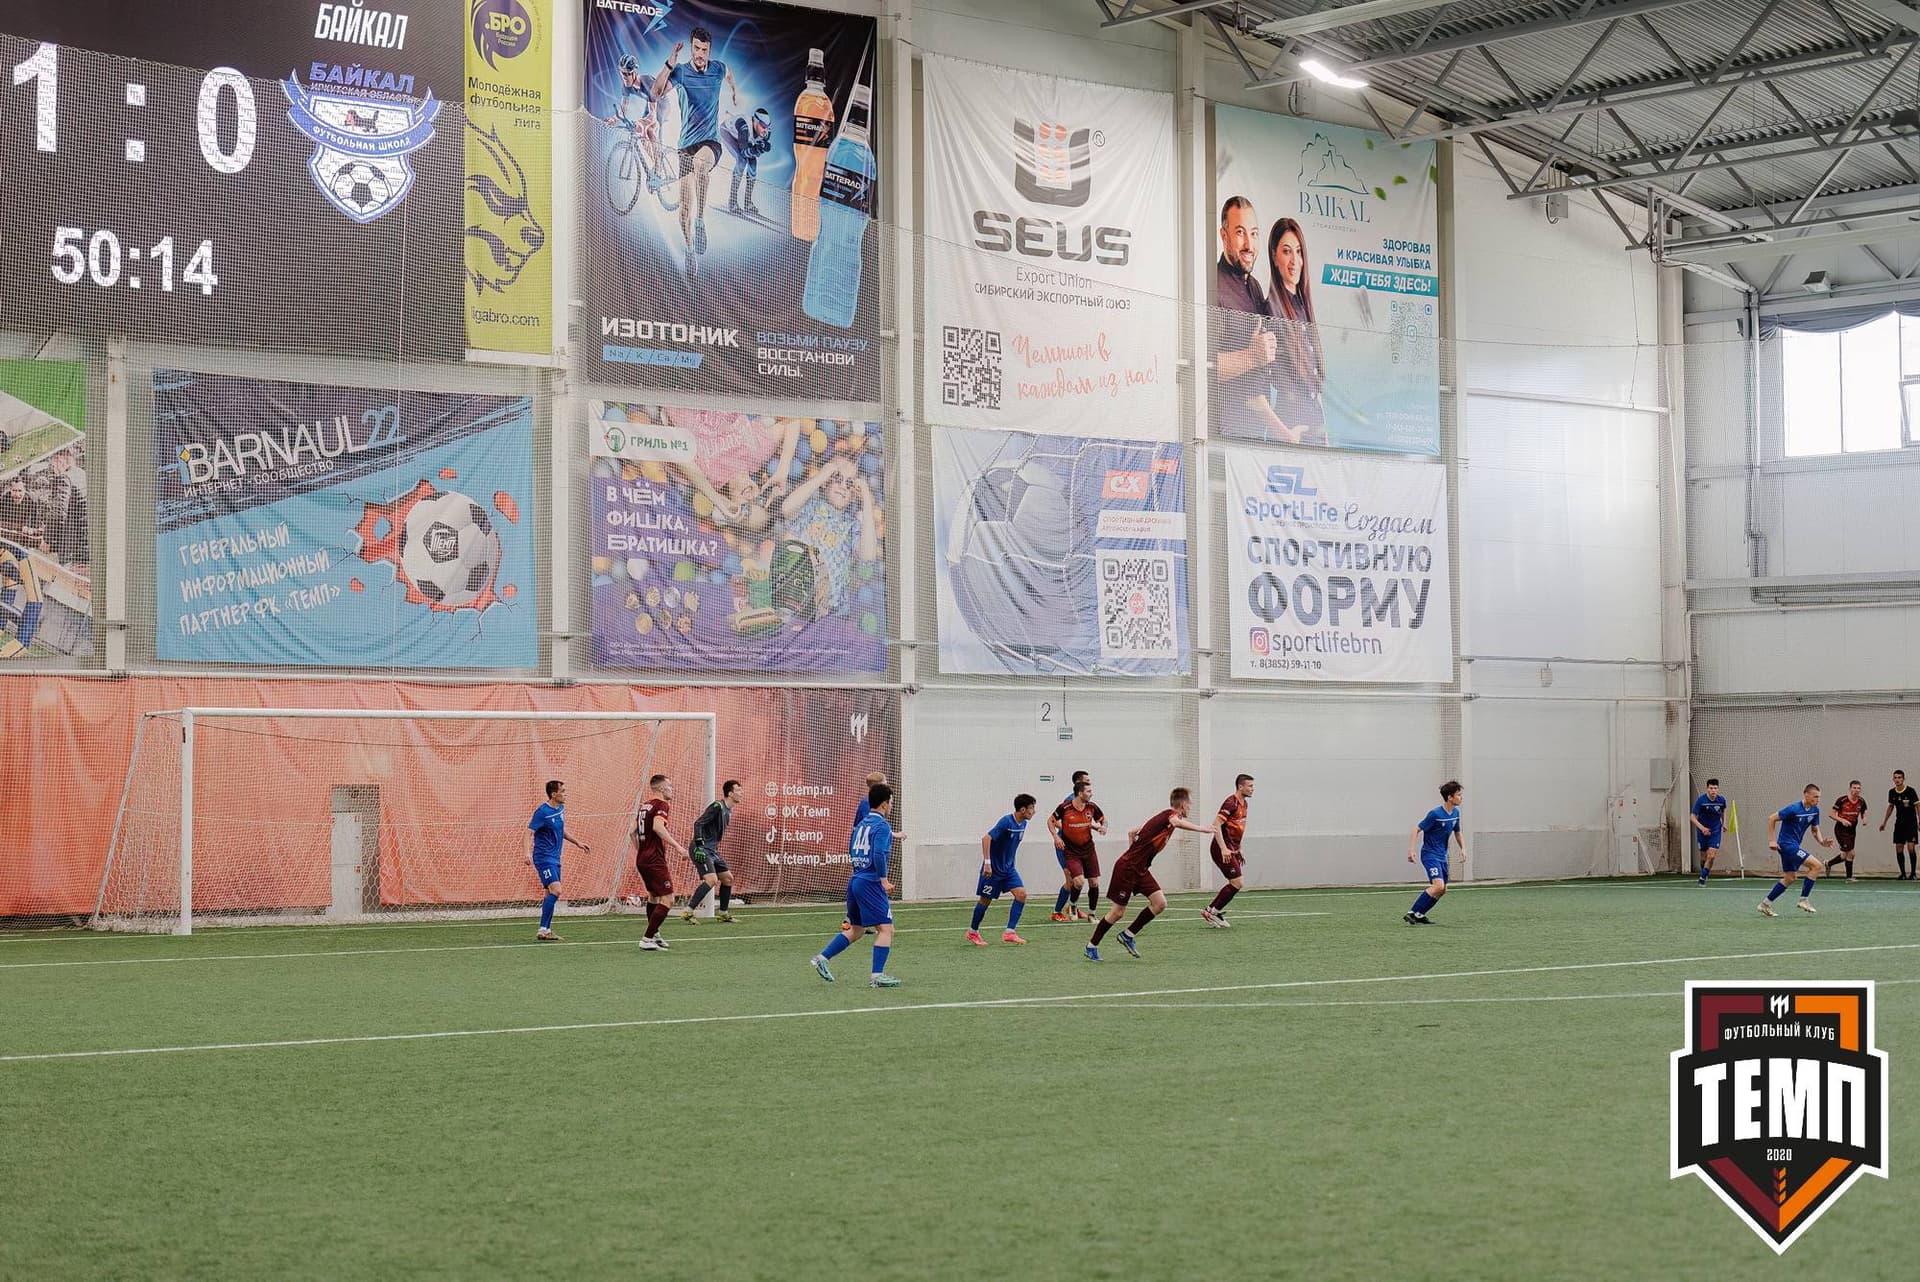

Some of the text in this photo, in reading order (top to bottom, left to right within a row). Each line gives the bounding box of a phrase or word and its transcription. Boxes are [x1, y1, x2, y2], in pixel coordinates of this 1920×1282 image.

[314, 0, 409, 50] БАЙКАЛ
[309, 61, 415, 94] БАЙКАЛ
[468, 77, 541, 99] Молодёжная
[13, 42, 58, 152] 1
[198, 66, 256, 174] 0
[470, 93, 541, 115] футбольная
[514, 118, 541, 130] лига
[312, 126, 411, 151] ФУТБОЛЬНАЯ ШКОЛА
[1299, 191, 1372, 223] BAIKAL
[973, 210, 1132, 266] SEUS
[1383, 238, 1431, 255] ЗДОРОВАЯ
[51, 226, 218, 295] 50:14
[1337, 249, 1432, 271] И КРАСИВАЯ УЛЫБКА
[1016, 266, 1092, 289] Export Union
[1330, 268, 1432, 293] ЖДЕТ ТЕБЯ ЗДЕСЬ!
[975, 282, 1131, 311] СИБИРСКИЙ ЭКСПОРТНЫЙ СОЮЗ
[602, 316, 738, 348] ИЗОТОНИК
[756, 331, 819, 347] ВОЗЬМИ
[757, 347, 855, 366] ВОССТАНОВИ
[1012, 331, 1111, 369] Чемпион в
[757, 363, 804, 378] СИЛЫ.
[1018, 354, 1159, 400] каждом из нас!
[630, 436, 689, 451] ГРИЛЬ №1
[183, 477, 244, 498] ИНТЕРНЕТ
[254, 460, 334, 486] СООБЩЕСТВО
[1264, 465, 1318, 496] SL
[606, 481, 666, 507] В ЧЁМ
[607, 510, 690, 534] ФИШКА,
[1245, 497, 1338, 523] SportLife
[1344, 502, 1436, 541] Создаем
[178, 521, 290, 567] ГЕНЕРАЛЬНЫЙ
[607, 534, 718, 556] БРАТИШКА?
[1247, 536, 1432, 573] СПОРТИВНУЮ
[180, 546, 330, 602] ИНФОРМАЦИОННЫЙ
[179, 583, 341, 636] ПАРТНЕР ФК «ТЕМП»
[1248, 572, 1431, 629] ФОРМУ
[1272, 631, 1383, 657] sportlifebrn
[1041, 702, 1051, 722] 2
[783, 782, 833, 799] fctemp.ru
[782, 805, 830, 818] ФК Темп
[783, 829, 823, 843] fc.temp
[853, 826, 871, 855] 44
[543, 869, 552, 879] 21
[982, 885, 993, 895] 22
